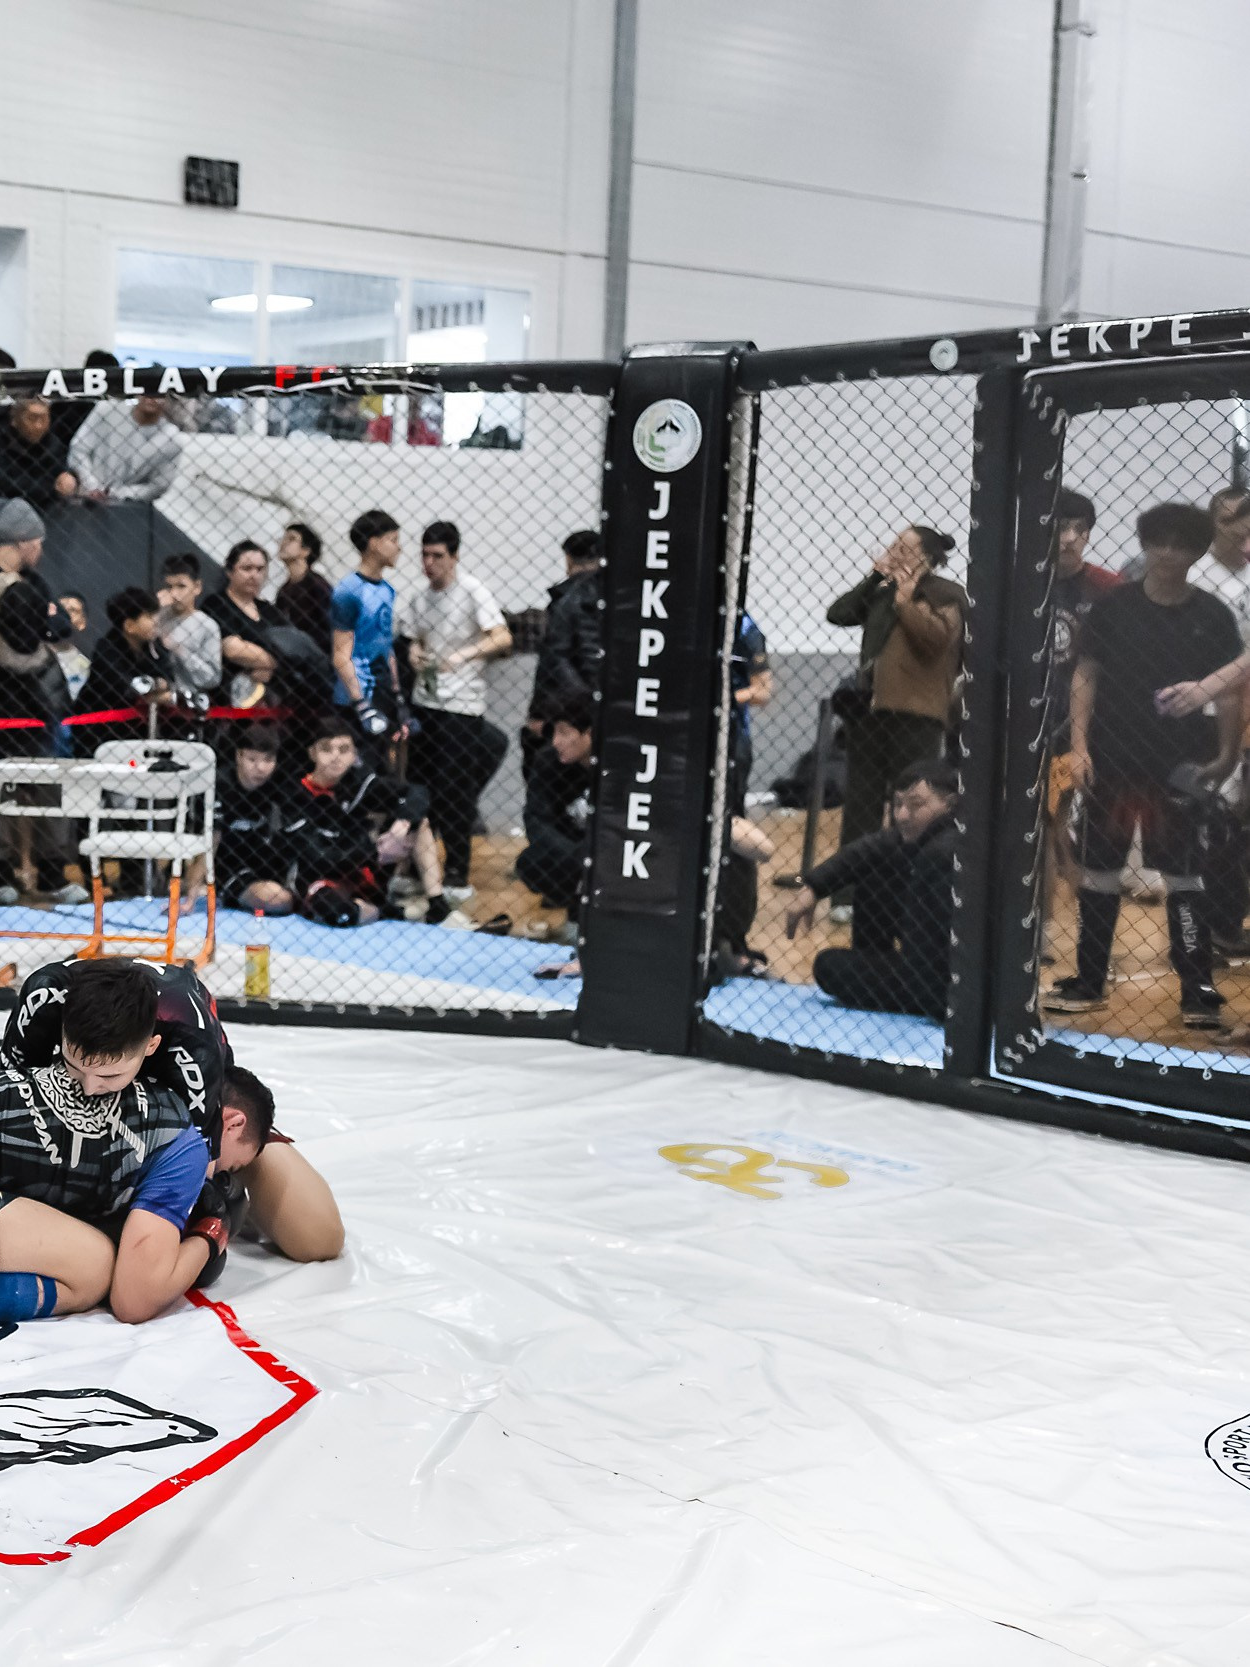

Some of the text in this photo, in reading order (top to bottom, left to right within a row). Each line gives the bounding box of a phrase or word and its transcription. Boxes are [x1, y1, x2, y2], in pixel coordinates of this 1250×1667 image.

[1016, 317, 1192, 363] JEKPE
[42, 366, 228, 396] ABLAY
[634, 481, 671, 718] JEKPE
[621, 744, 659, 880] JEK
[17, 987, 69, 1038] RDX
[168, 1046, 206, 1114] RDX
